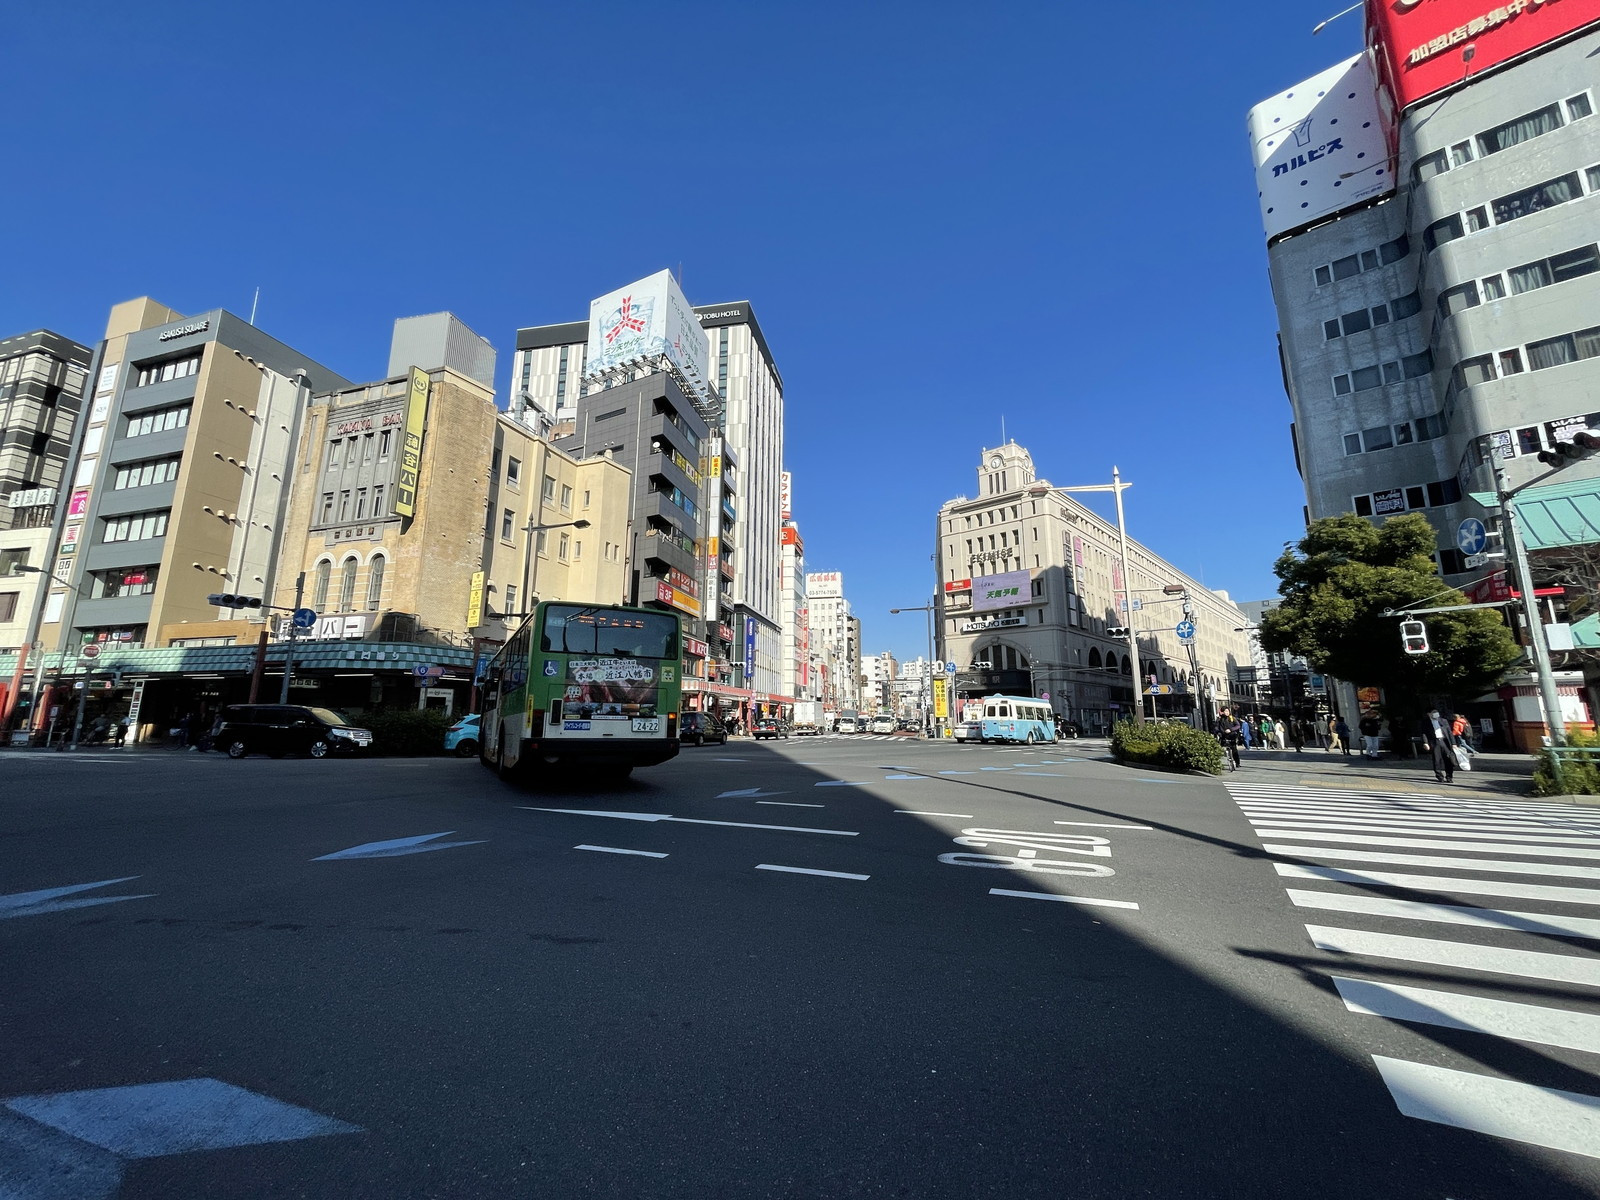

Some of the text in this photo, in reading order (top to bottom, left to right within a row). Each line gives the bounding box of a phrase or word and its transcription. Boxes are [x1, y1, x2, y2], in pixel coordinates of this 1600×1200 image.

[1410, 0, 1528, 63] 加盟店募集中
[1272, 136, 1344, 177] カルピス
[703, 309, 741, 320] TOBU HOTEL
[158, 320, 208, 341] ASAKUSA SQUARE
[337, 419, 373, 436] KAMIYA
[400, 434, 420, 506] 神谷バー
[969, 547, 1014, 563] EKIMISE
[966, 620, 1000, 630] MATSUYA
